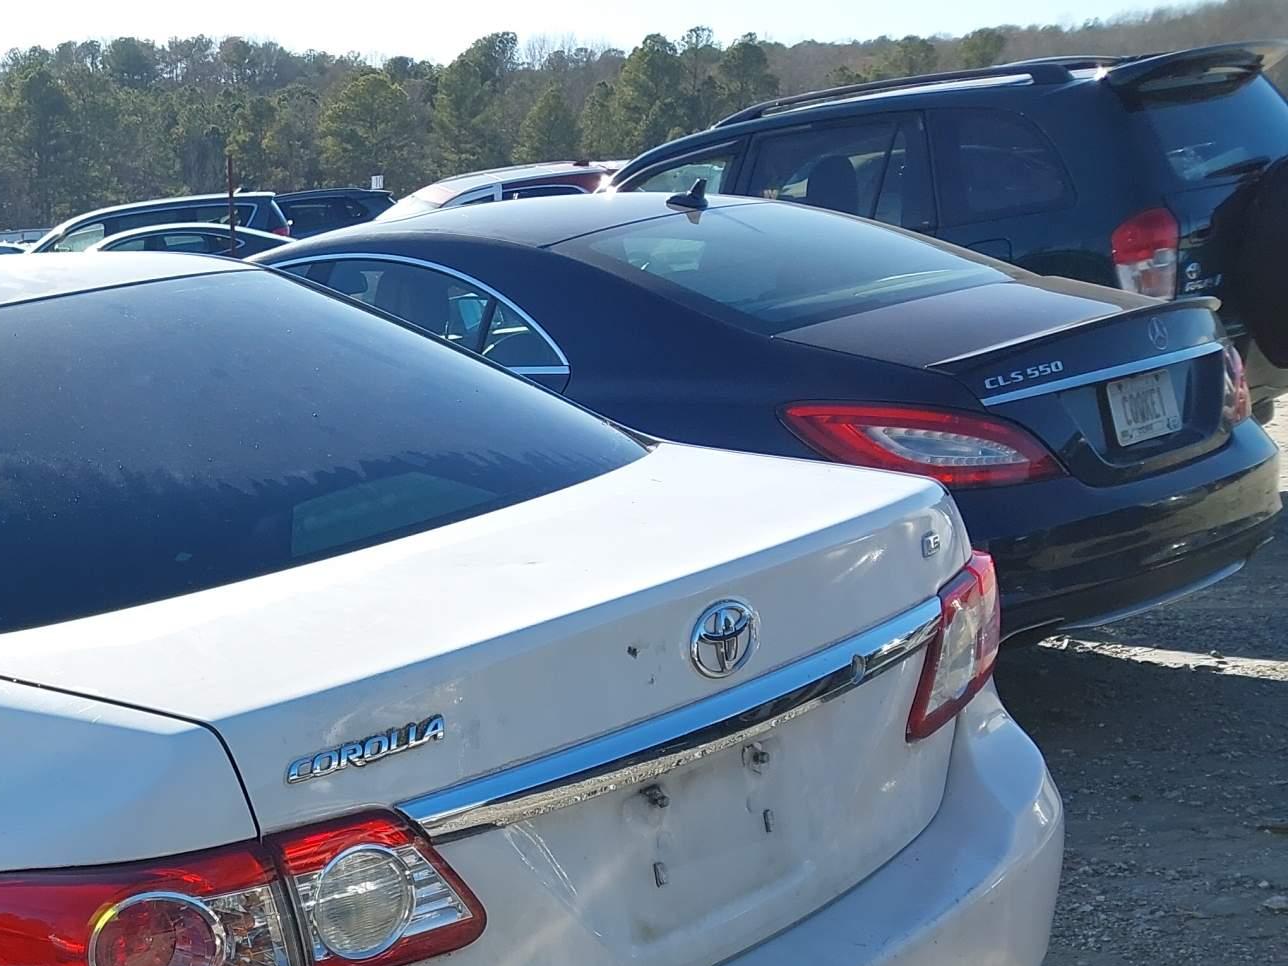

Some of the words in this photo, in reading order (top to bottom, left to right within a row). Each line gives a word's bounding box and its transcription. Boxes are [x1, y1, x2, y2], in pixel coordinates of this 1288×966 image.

[984, 370, 1024, 390] CLS
[1027, 360, 1064, 380] 550
[286, 713, 446, 784] COROLLA
